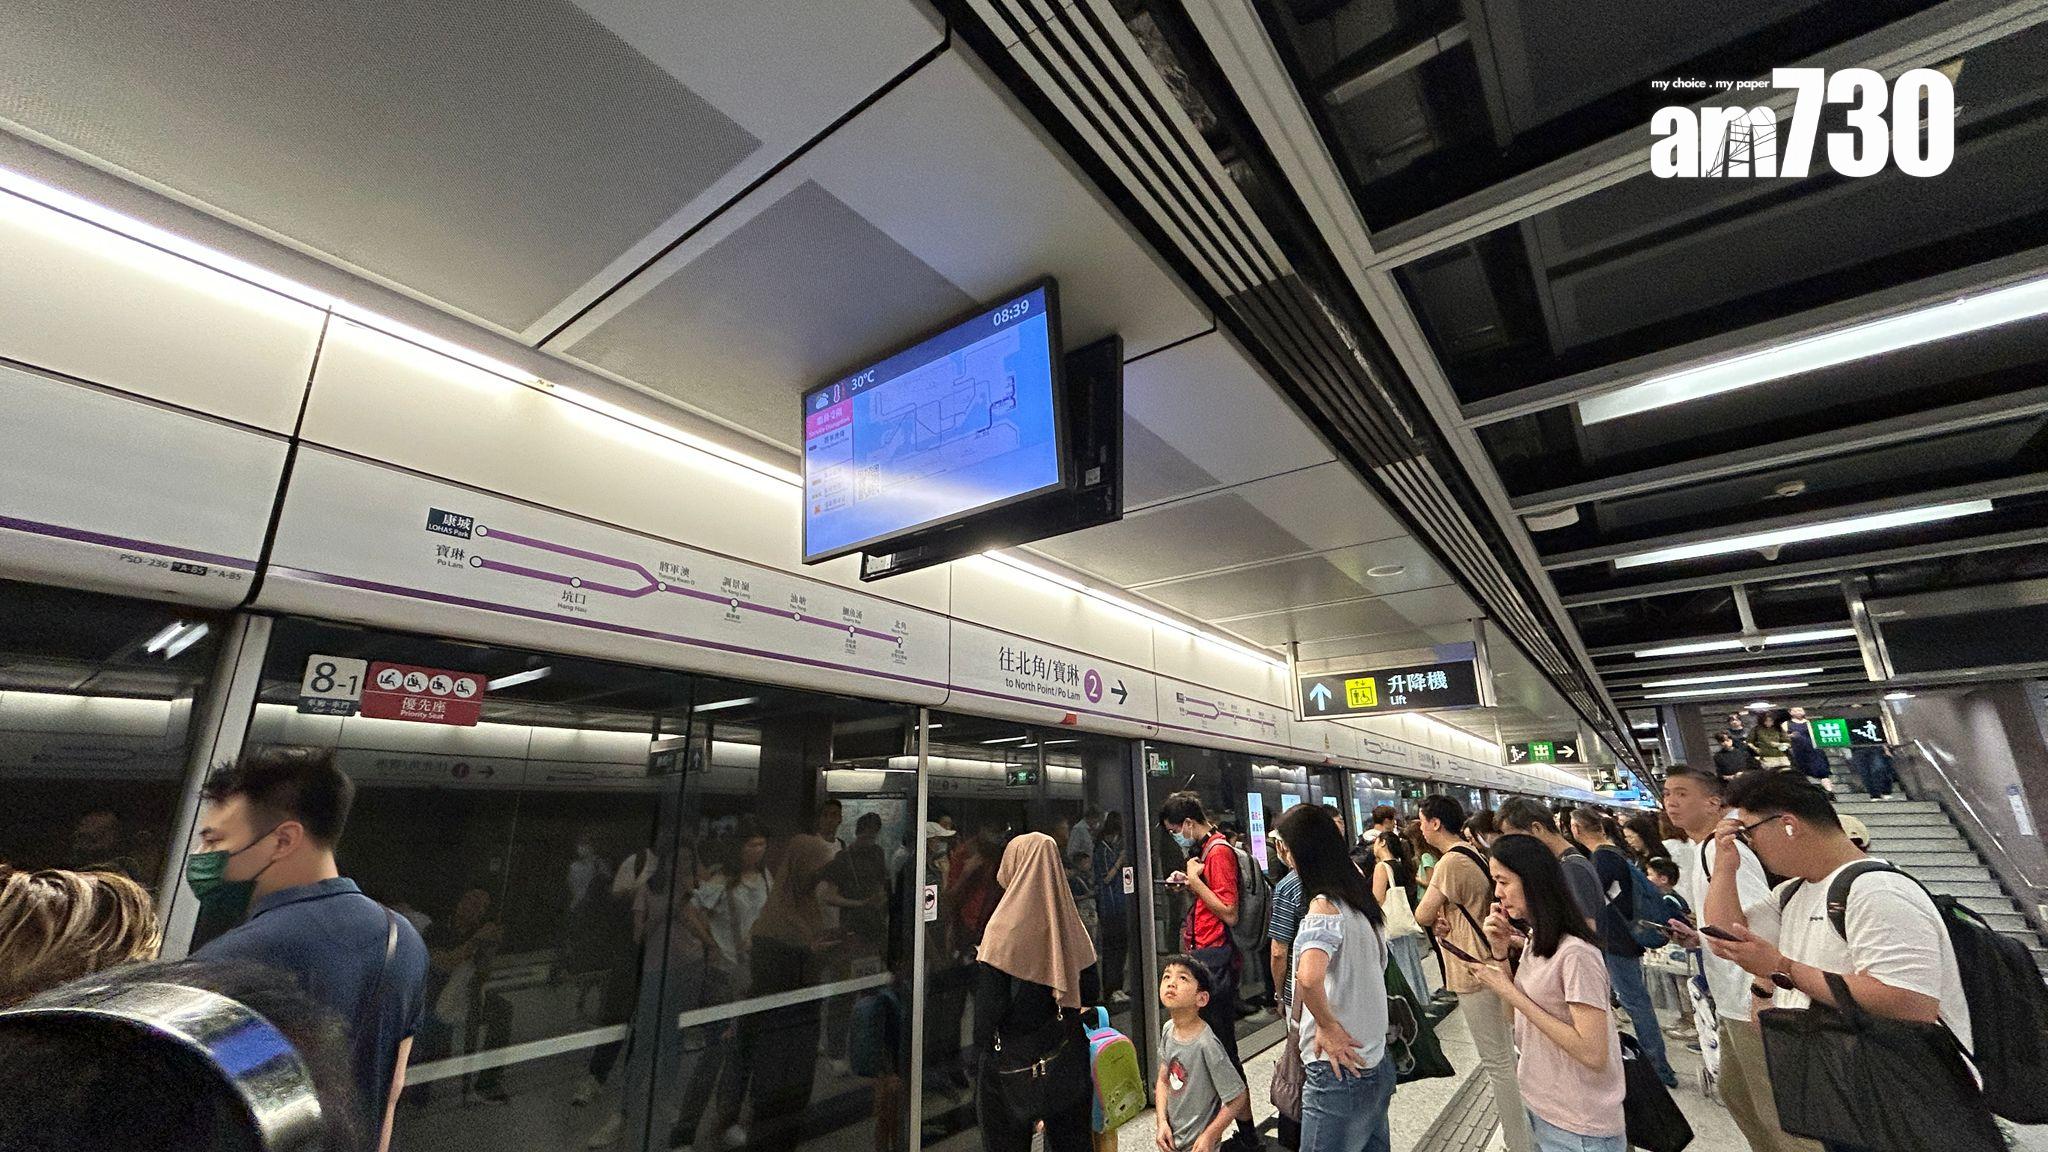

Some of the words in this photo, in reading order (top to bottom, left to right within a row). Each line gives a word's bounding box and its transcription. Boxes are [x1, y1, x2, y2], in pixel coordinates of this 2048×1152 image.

[993, 300, 1029, 326] 08:39
[428, 524, 453, 534] LOHAS
[453, 529, 469, 538] Park
[562, 590, 586, 604] 坑口
[557, 603, 574, 612] Hang
[999, 646, 1079, 686] 往北角/寶琳
[311, 661, 358, 696] 8-1
[1089, 675, 1098, 697] 2
[1387, 671, 1448, 693] 升降機
[1005, 678, 1013, 688] to
[1015, 679, 1036, 692] North
[1067, 689, 1080, 700] Lam
[402, 697, 446, 713] 優先座
[1391, 695, 1407, 705] Lift
[400, 709, 428, 719] Priority
[429, 712, 444, 720] Seat
